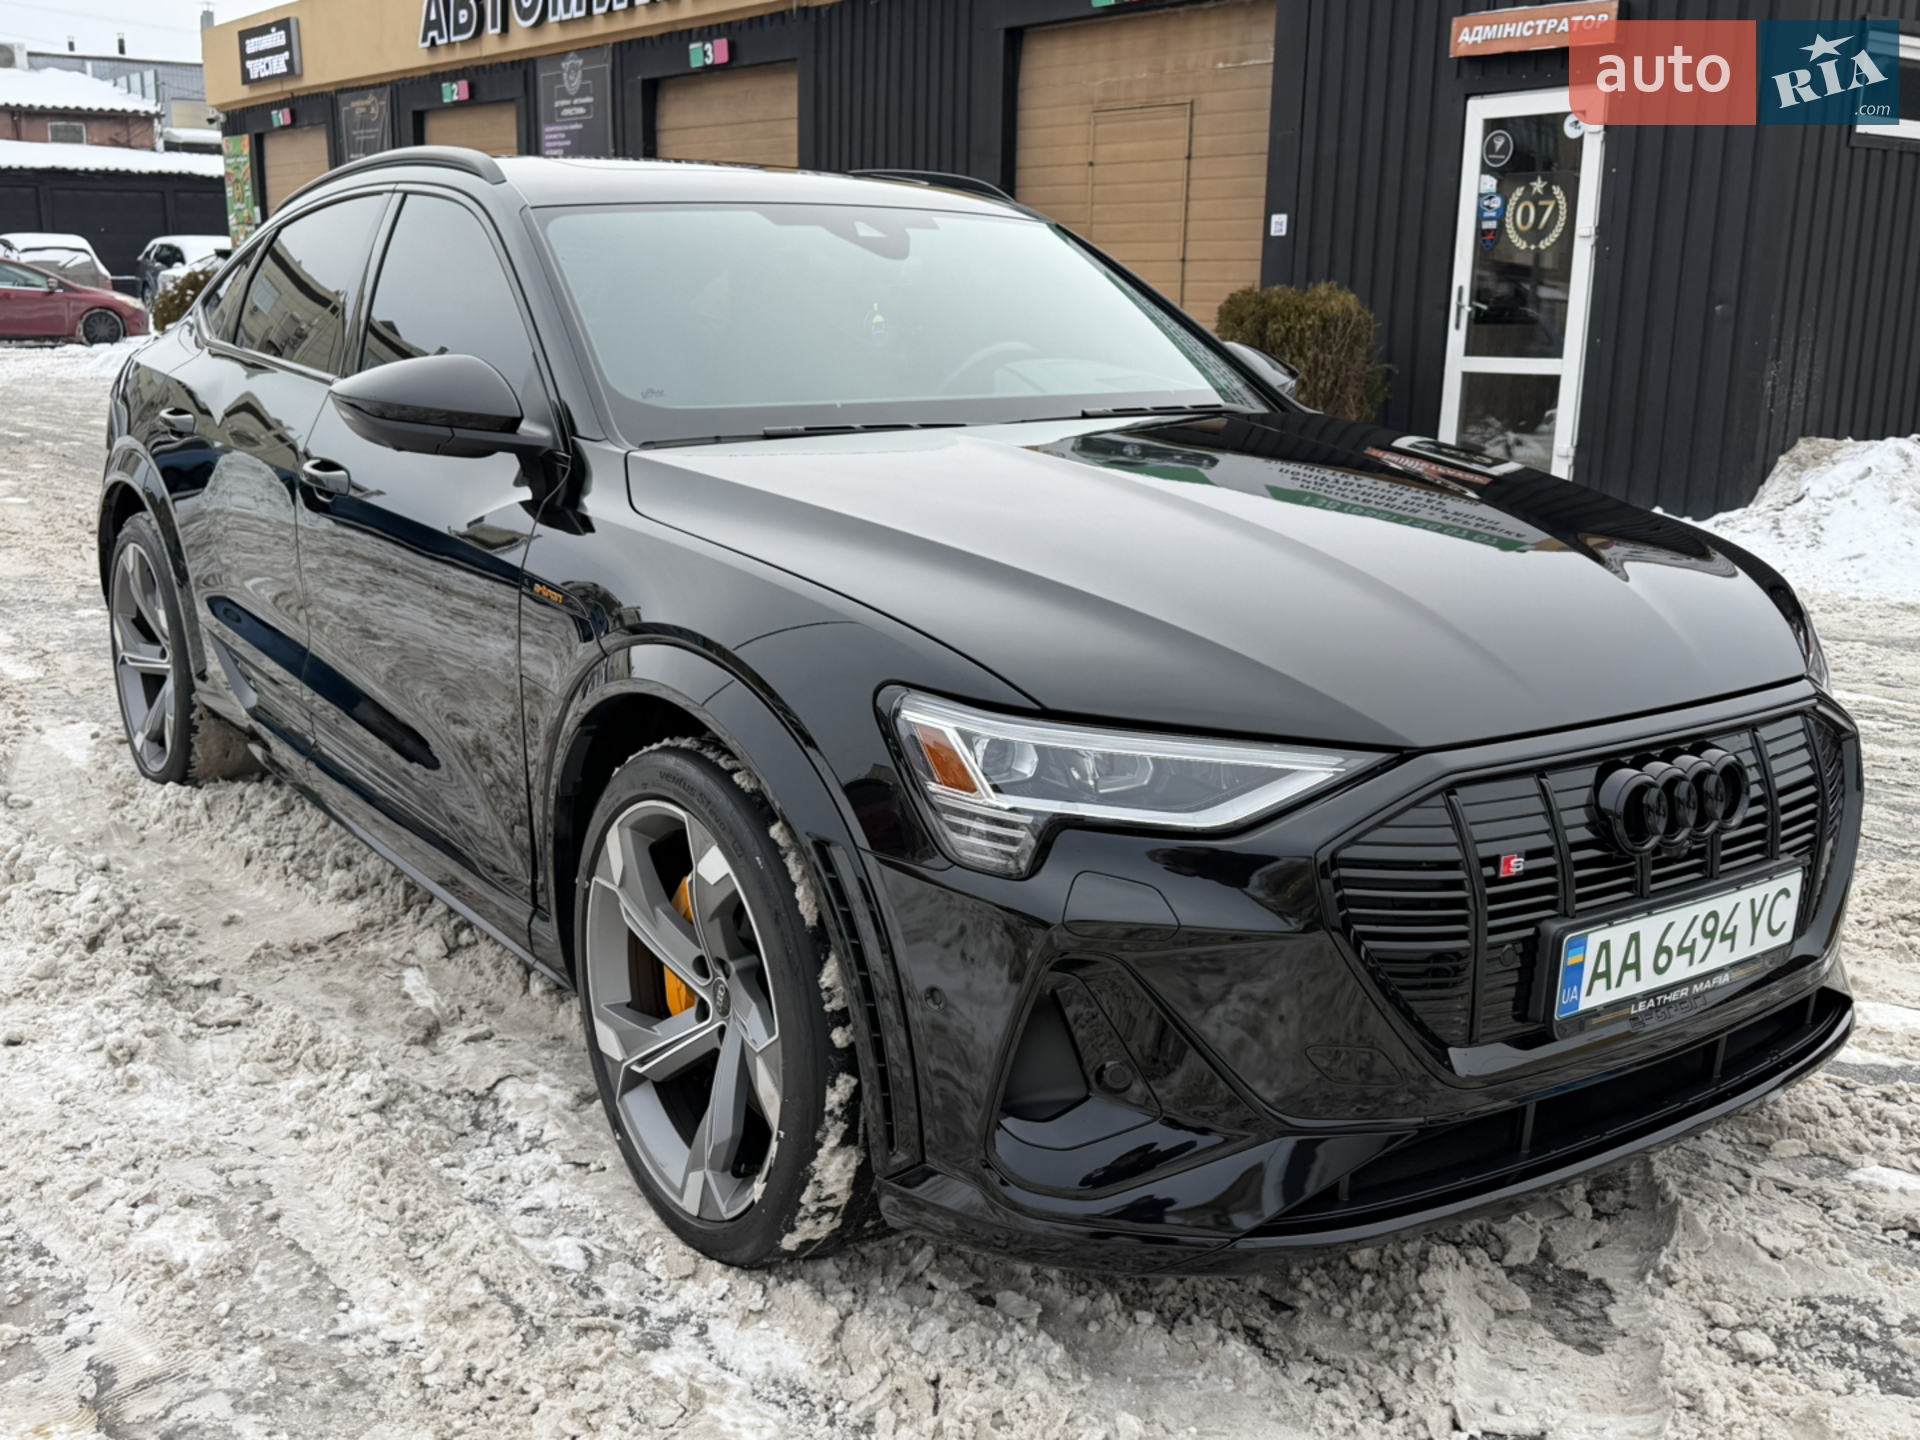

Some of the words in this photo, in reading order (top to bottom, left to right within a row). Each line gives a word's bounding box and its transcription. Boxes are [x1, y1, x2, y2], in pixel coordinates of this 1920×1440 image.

[1458, 13, 1609, 44] АДМІНІСТРАТОР
[704, 43, 713, 65] 3
[451, 83, 459, 101] 2
[1516, 200, 1556, 231] 07
[1585, 930, 1642, 997] AA
[1652, 901, 1741, 976] 6494
[1750, 887, 1792, 947] YC
[1562, 986, 1579, 1005] UA
[1630, 987, 1689, 1014] LEATHER
[1692, 974, 1730, 994] MAFIA
